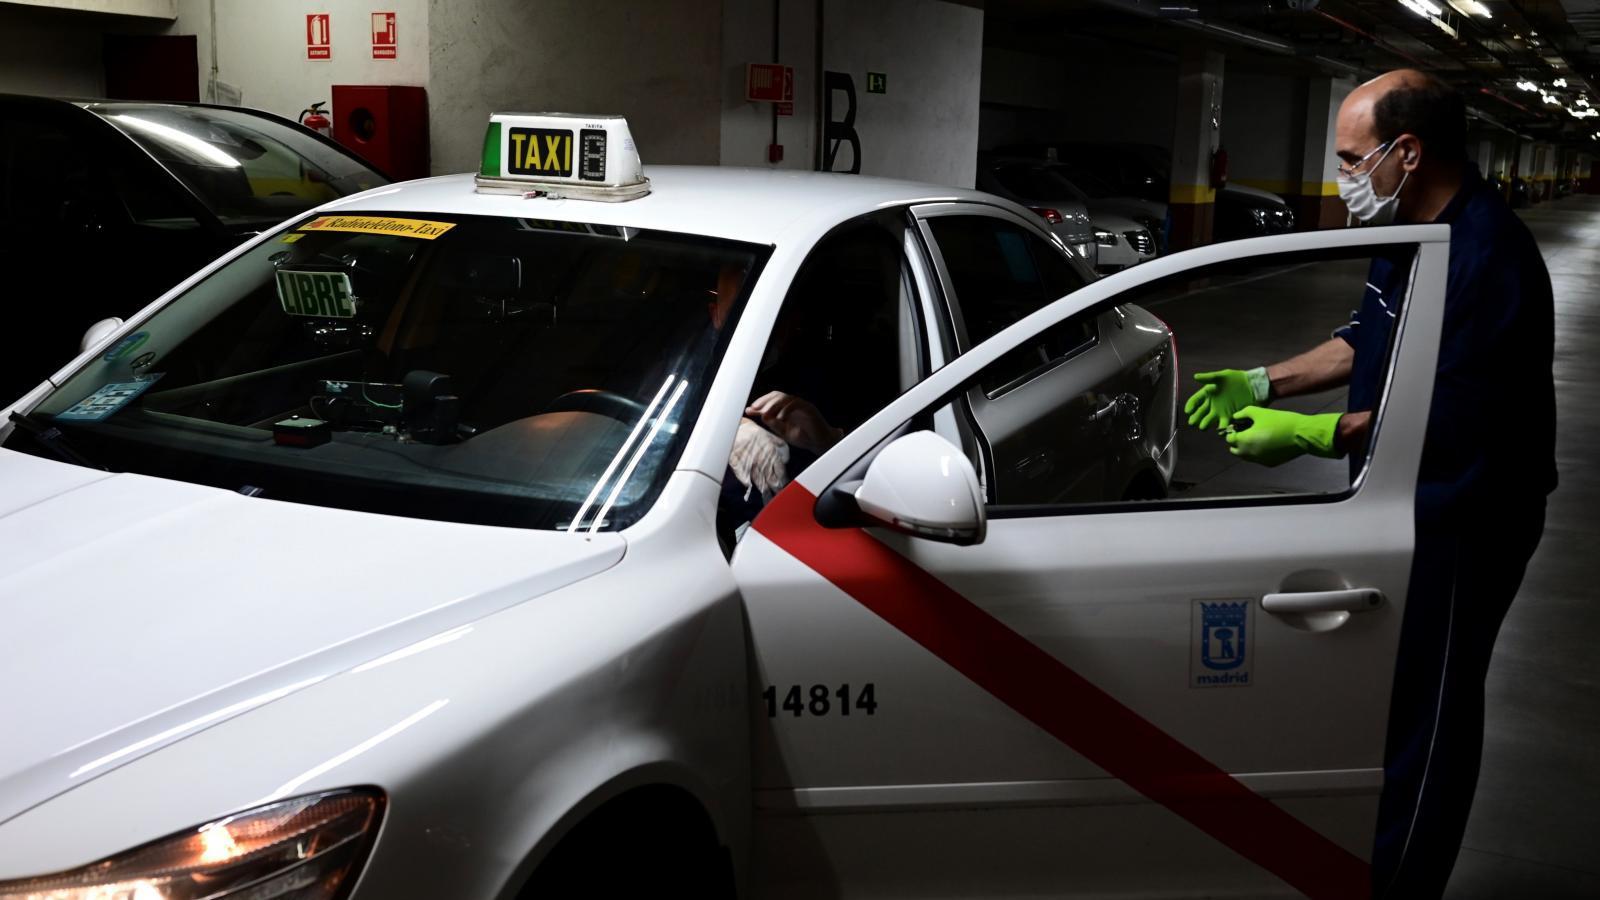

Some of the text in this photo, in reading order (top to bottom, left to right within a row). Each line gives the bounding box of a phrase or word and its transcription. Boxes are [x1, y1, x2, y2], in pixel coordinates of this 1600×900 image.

[511, 133, 571, 171] TAXI
[278, 271, 352, 316] LIBRE
[1197, 672, 1248, 684] madrid
[762, 683, 877, 717] 14814
